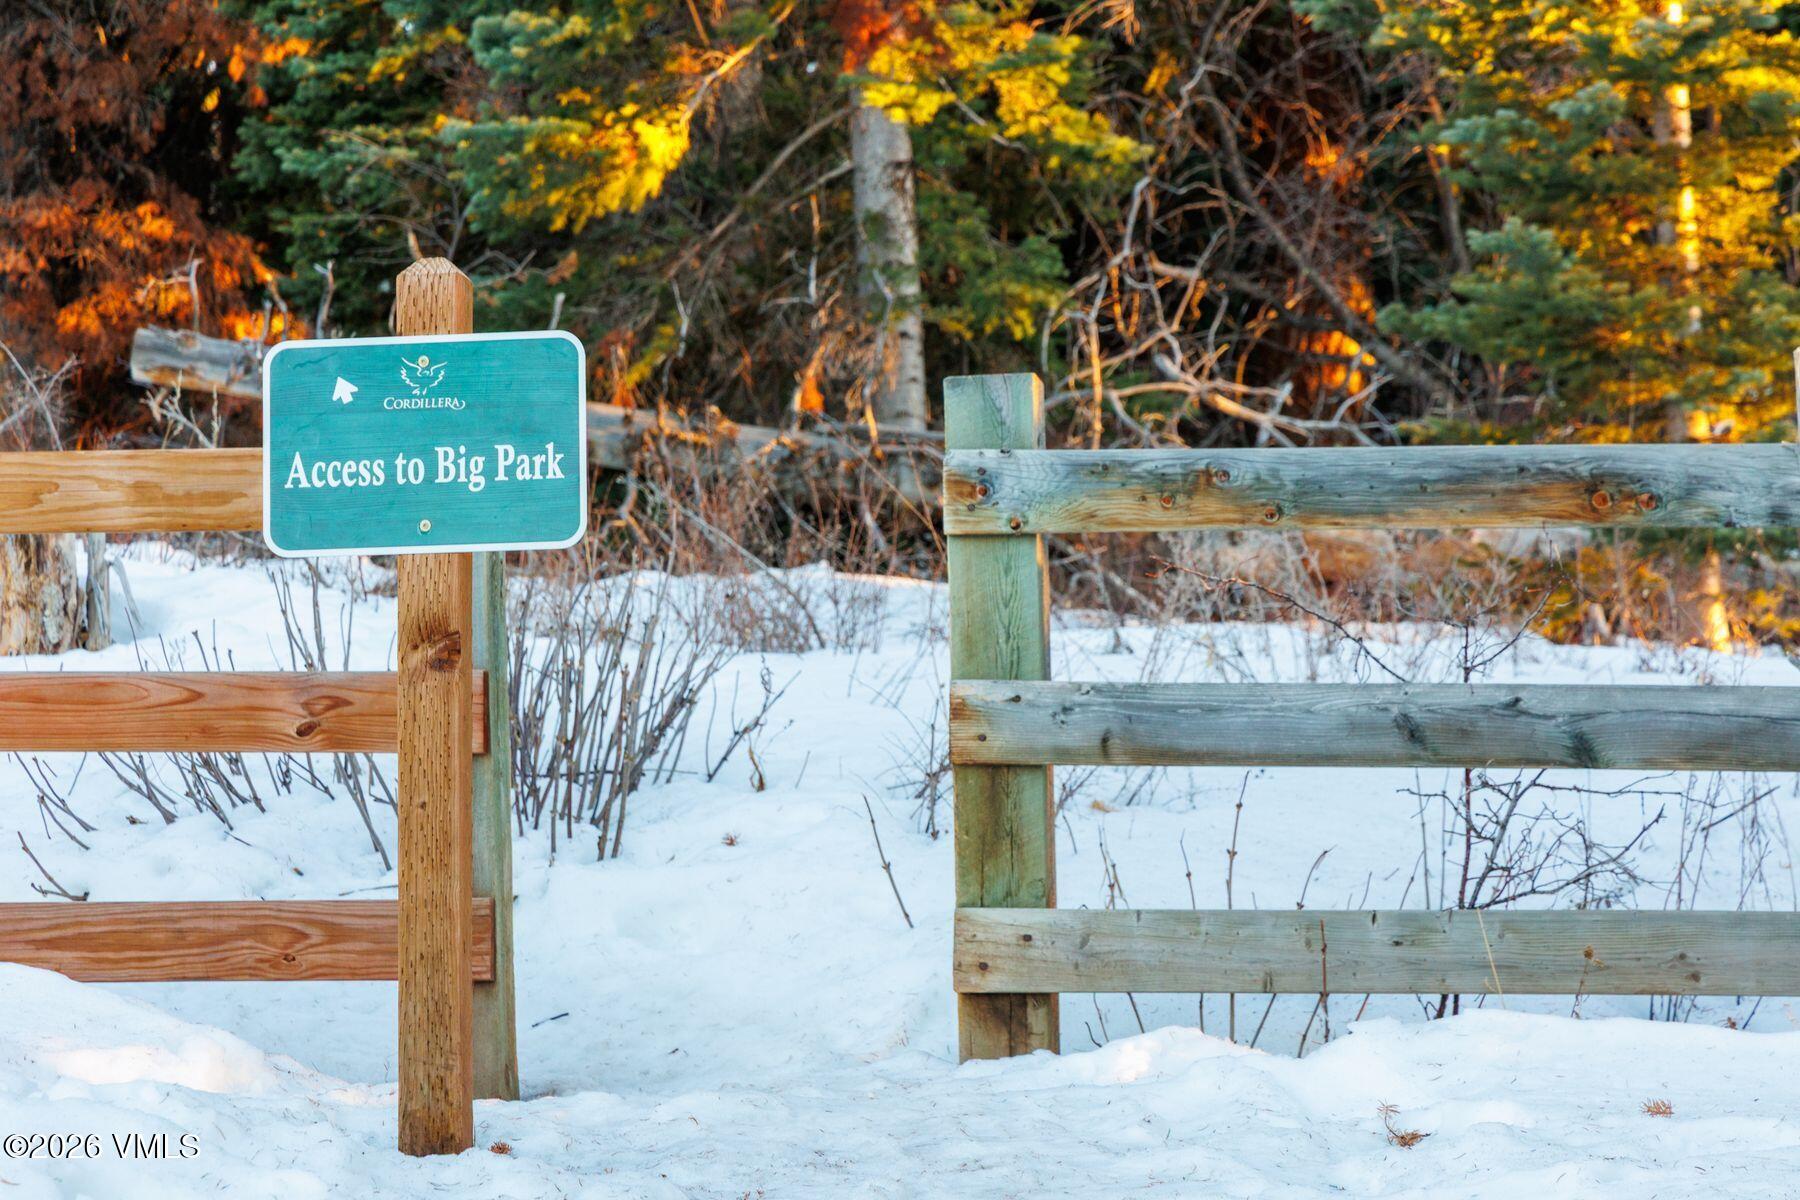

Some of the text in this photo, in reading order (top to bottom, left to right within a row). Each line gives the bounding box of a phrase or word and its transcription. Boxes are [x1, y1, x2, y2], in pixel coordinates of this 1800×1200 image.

[284, 442, 565, 492] Access to Big Park
